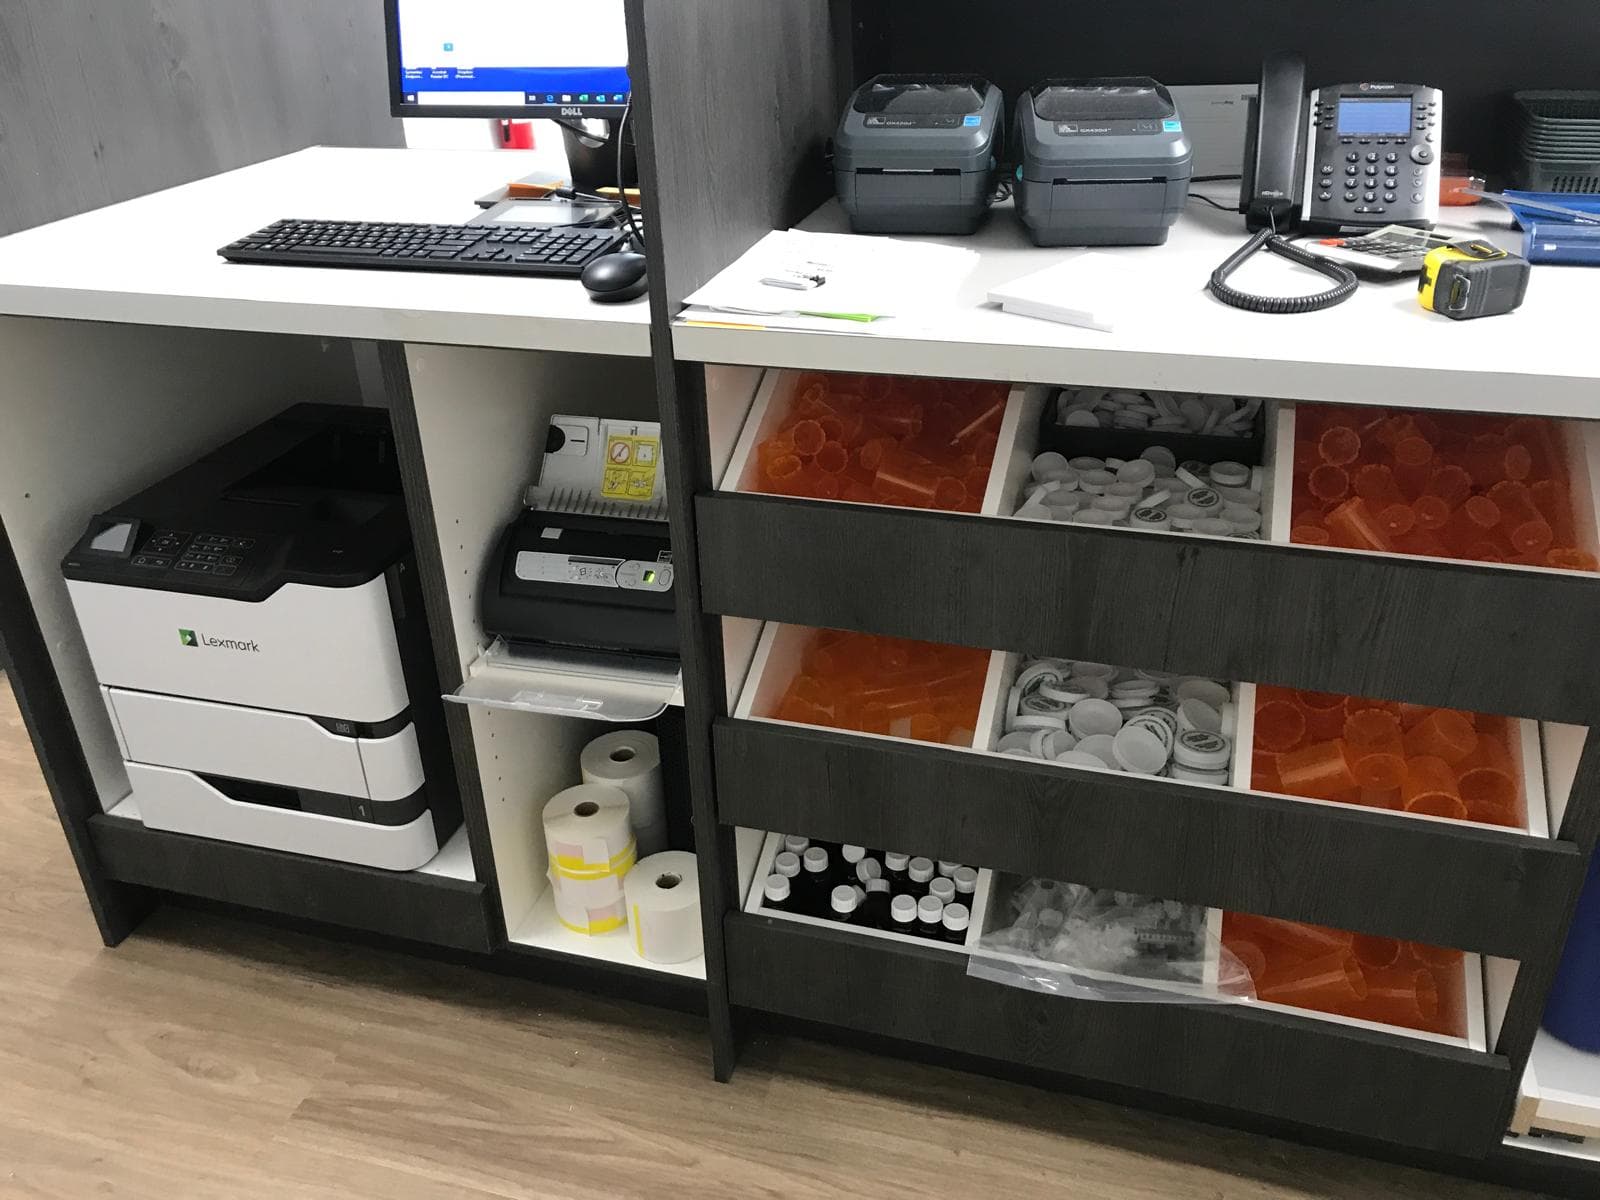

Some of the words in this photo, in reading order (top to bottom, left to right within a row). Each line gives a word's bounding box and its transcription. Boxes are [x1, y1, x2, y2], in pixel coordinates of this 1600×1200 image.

[561, 107, 583, 116] DELL
[201, 633, 260, 652] Lexmark
[358, 805, 366, 817] 1
